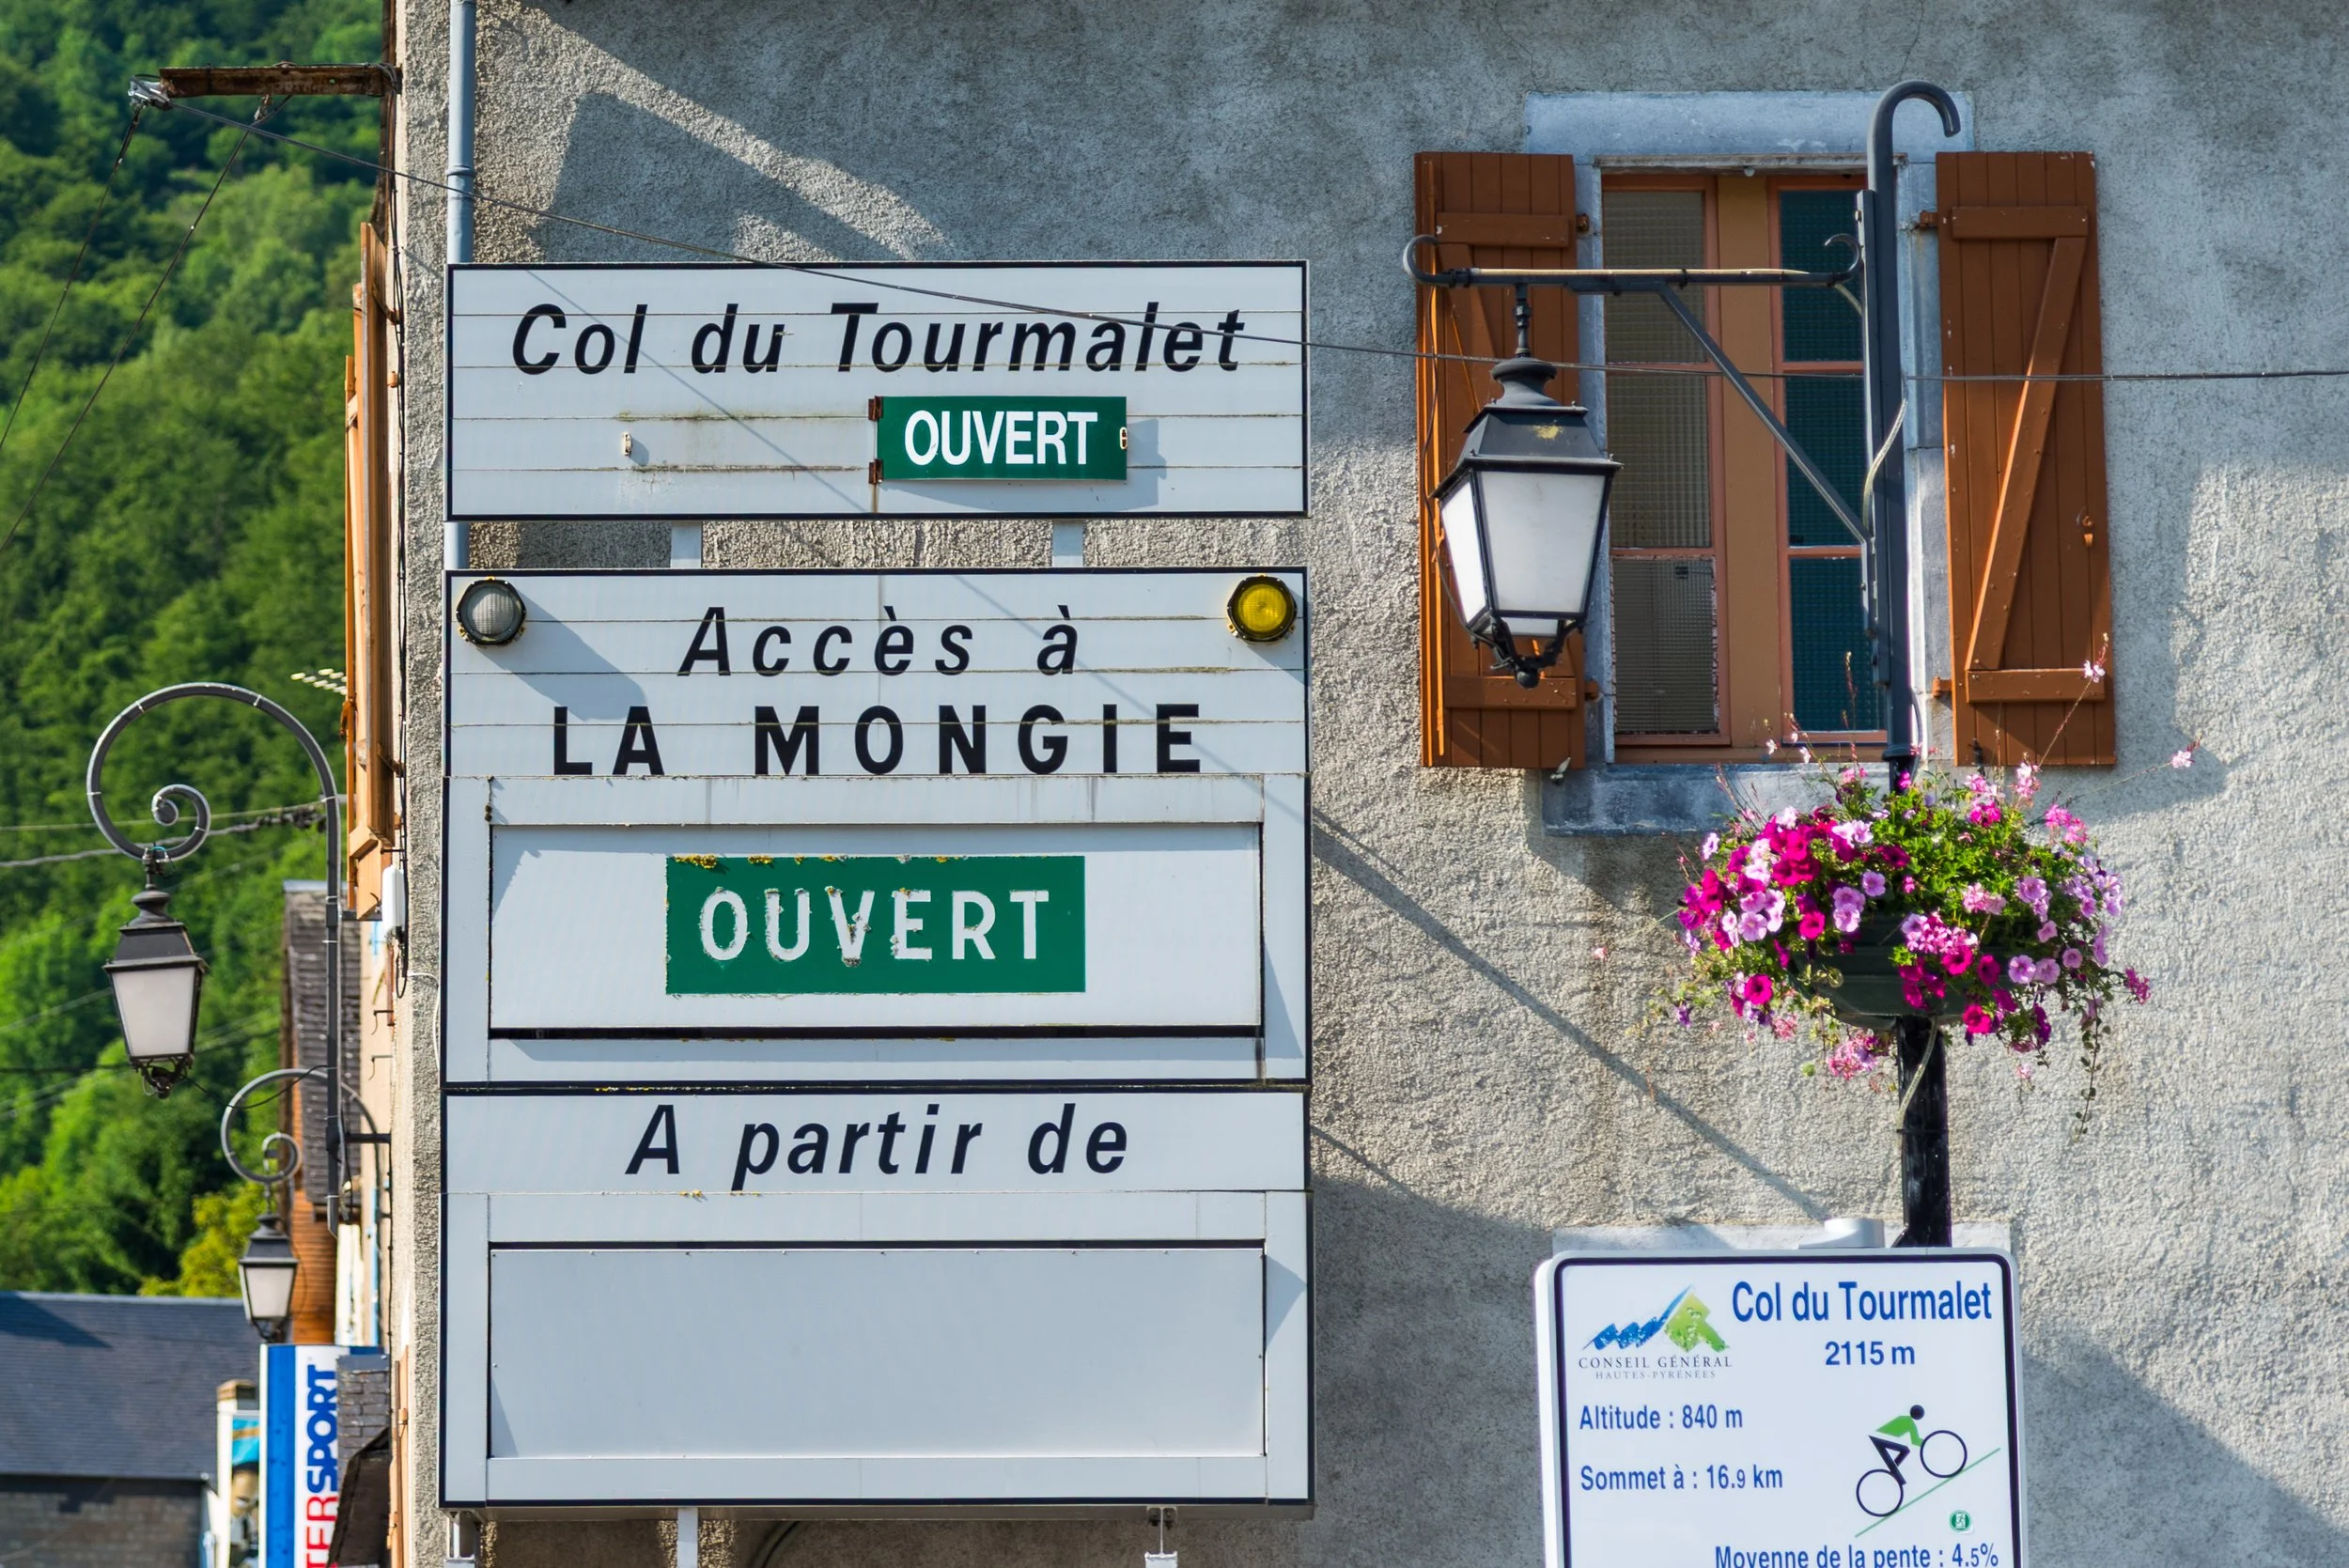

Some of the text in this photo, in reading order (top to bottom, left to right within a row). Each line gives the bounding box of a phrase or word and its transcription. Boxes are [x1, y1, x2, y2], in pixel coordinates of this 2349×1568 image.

[512, 302, 1245, 375] Col du Tourmalet
[904, 410, 1098, 466] OUVERT
[677, 604, 1079, 677] Accès à
[553, 704, 1201, 777] LA MONGIE
[698, 888, 1050, 962] OUVERT
[625, 1103, 1128, 1191] A partir de
[1732, 1281, 1992, 1323] Col du Tourmalet
[1579, 1354, 1733, 1369] CONSEIL GÉNÉRAL
[1595, 1370, 1716, 1379] HAUTES-PYRÉNÉES
[1825, 1341, 1915, 1366] 2115 m
[1579, 1404, 1743, 1430] Altitude : 840 m
[1580, 1464, 1783, 1491] Sommet à : 16.9 km
[1715, 1543, 1999, 1568] Moyenne de la pente : 4.5%
